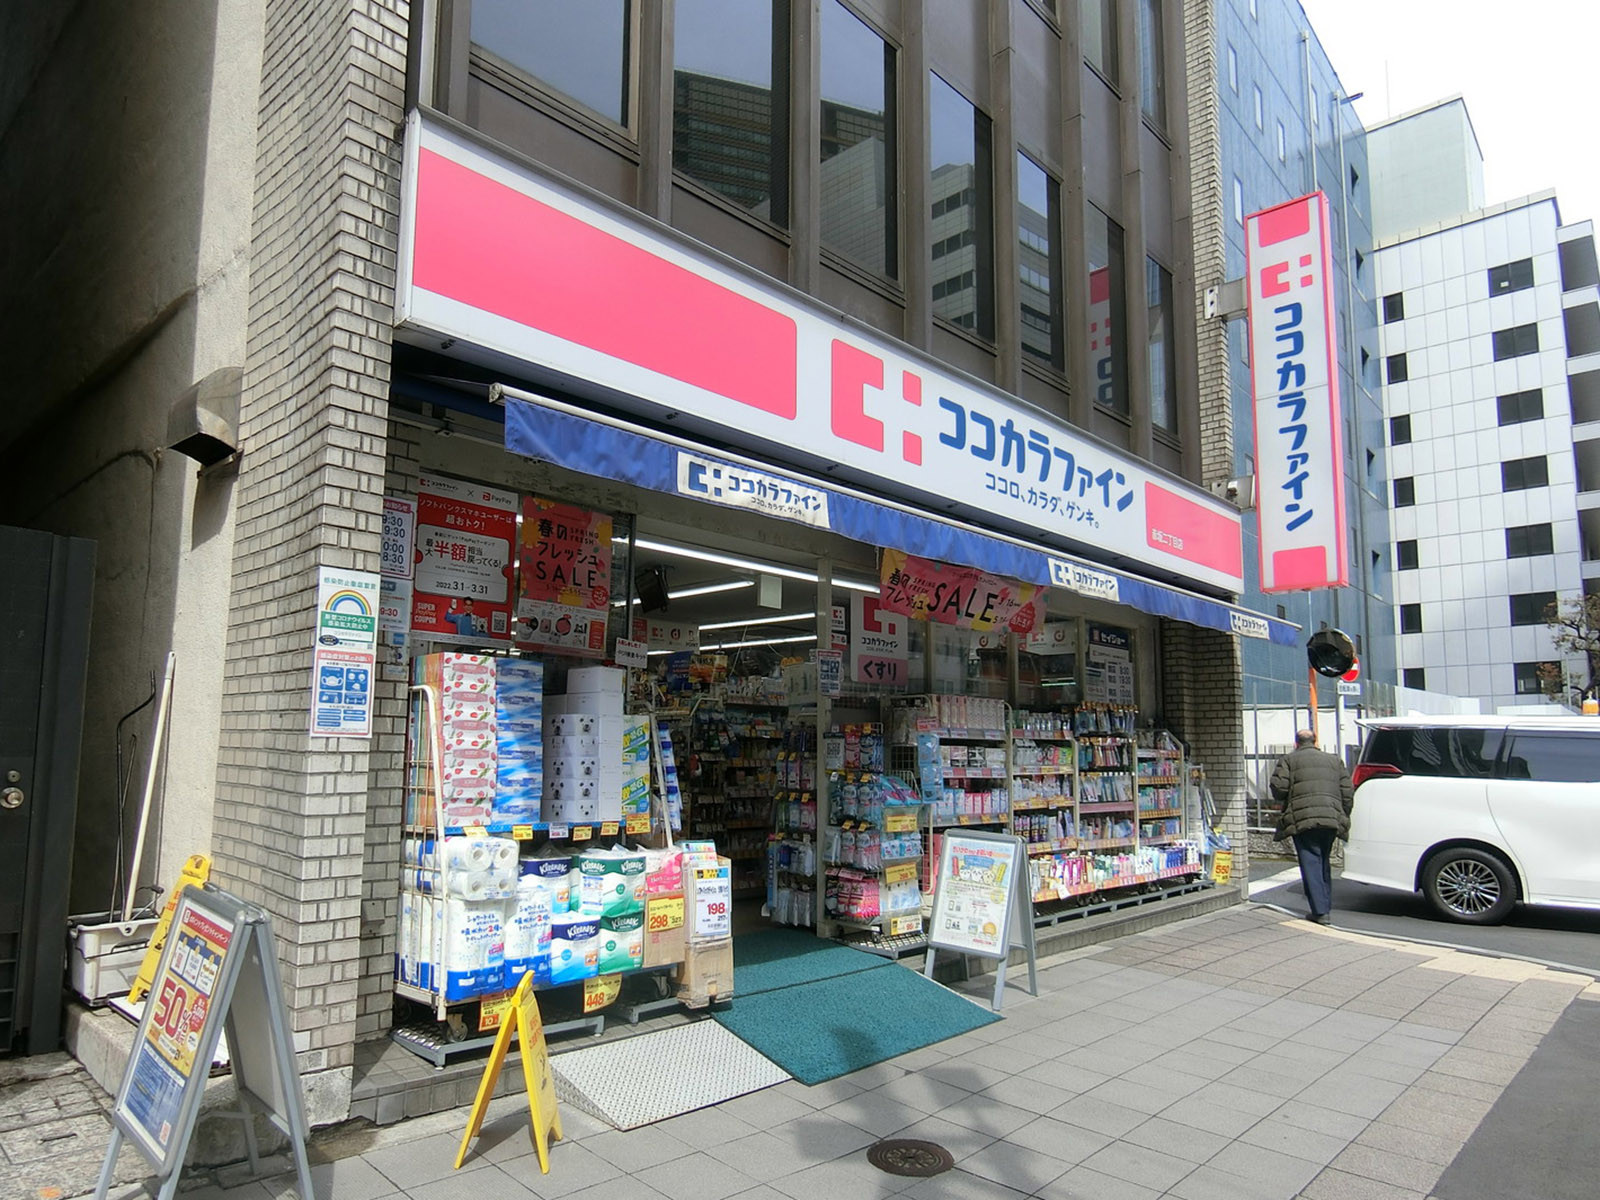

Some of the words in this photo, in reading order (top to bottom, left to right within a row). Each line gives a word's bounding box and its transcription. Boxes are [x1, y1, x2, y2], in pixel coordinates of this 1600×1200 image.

[1274, 302, 1313, 531] ココカラファイン
[938, 396, 1134, 512] ココカラファイン
[728, 475, 821, 511] ココカラファイン
[985, 472, 1100, 530] ココロ、カラダ、ゲンキ。
[419, 498, 512, 523] ソフトバンクスマホユーザーは
[537, 519, 568, 541] 春の
[569, 527, 600, 539] SPRING
[433, 540, 467, 563] 半額
[536, 541, 599, 566] フレッシュ
[535, 560, 597, 589] SALE
[926, 582, 999, 623] SALE
[861, 636, 898, 648] ココカラファイン
[863, 660, 897, 681] くすり
[539, 862, 568, 875] Kleenex
[581, 860, 605, 873] Kleenex
[620, 860, 644, 873] Kleenex
[707, 902, 725, 915] 198
[567, 924, 596, 939] Kleenex
[611, 916, 639, 930] Kleenex
[649, 914, 668, 930] 298
[586, 991, 605, 1007] 448
